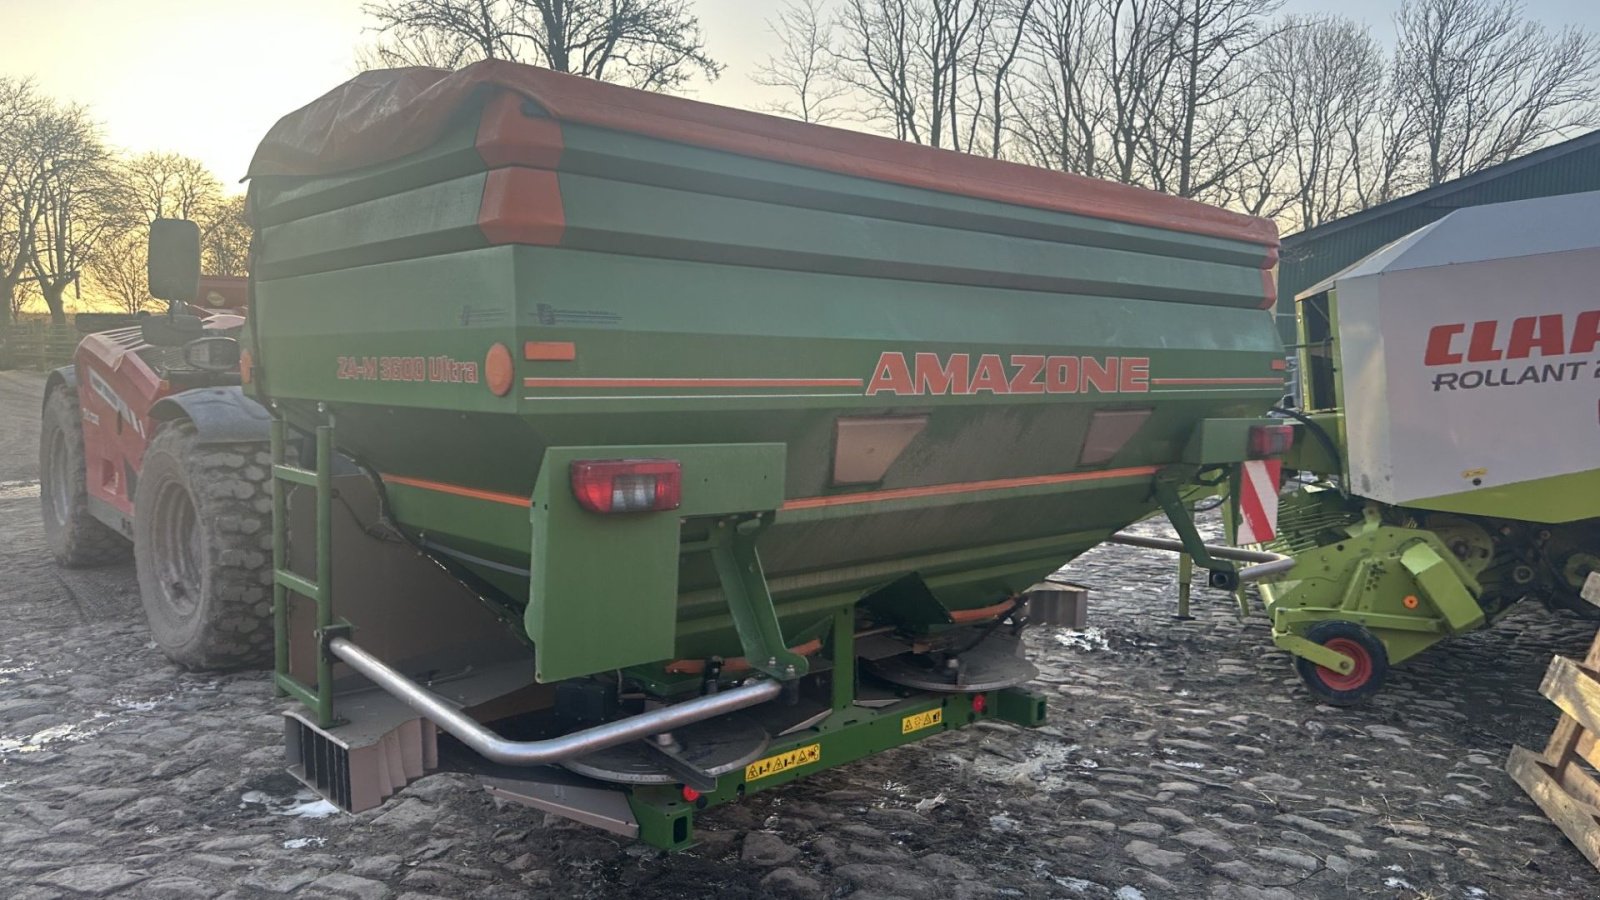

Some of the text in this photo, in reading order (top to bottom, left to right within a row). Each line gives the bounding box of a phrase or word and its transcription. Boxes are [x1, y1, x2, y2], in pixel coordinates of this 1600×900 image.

[336, 355, 479, 383] ZA-M 3600 Ultra
[865, 352, 1150, 396] AMAZONE
[1432, 361, 1588, 391] ROLLANT
